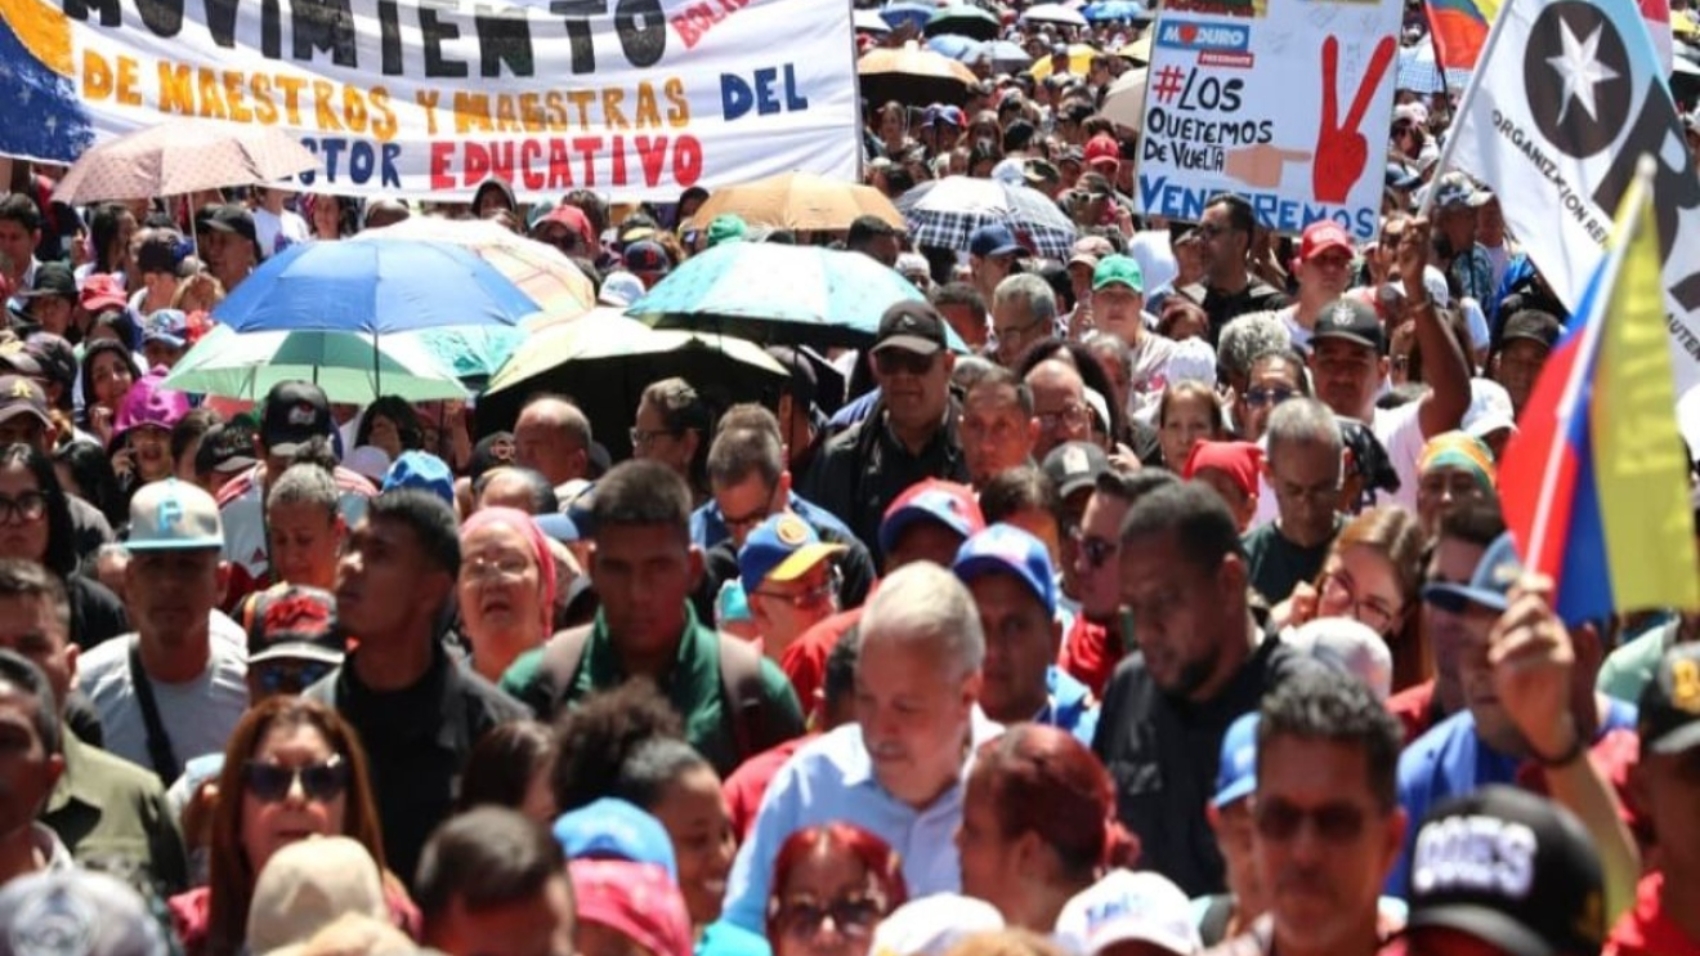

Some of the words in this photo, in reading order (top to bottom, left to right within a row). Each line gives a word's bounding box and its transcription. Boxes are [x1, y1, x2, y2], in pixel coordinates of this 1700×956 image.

[1163, 24, 1245, 47] MDURO
[82, 49, 142, 106] DE
[157, 60, 399, 141] MAESTROS
[416, 89, 440, 135] Y
[453, 77, 691, 135] MAESTRAS
[720, 62, 808, 121] DEL
[429, 134, 703, 190] EDUCATIVO
[1491, 108, 1589, 222] ORGANIZION
[1138, 174, 1375, 238] VENREMOS
